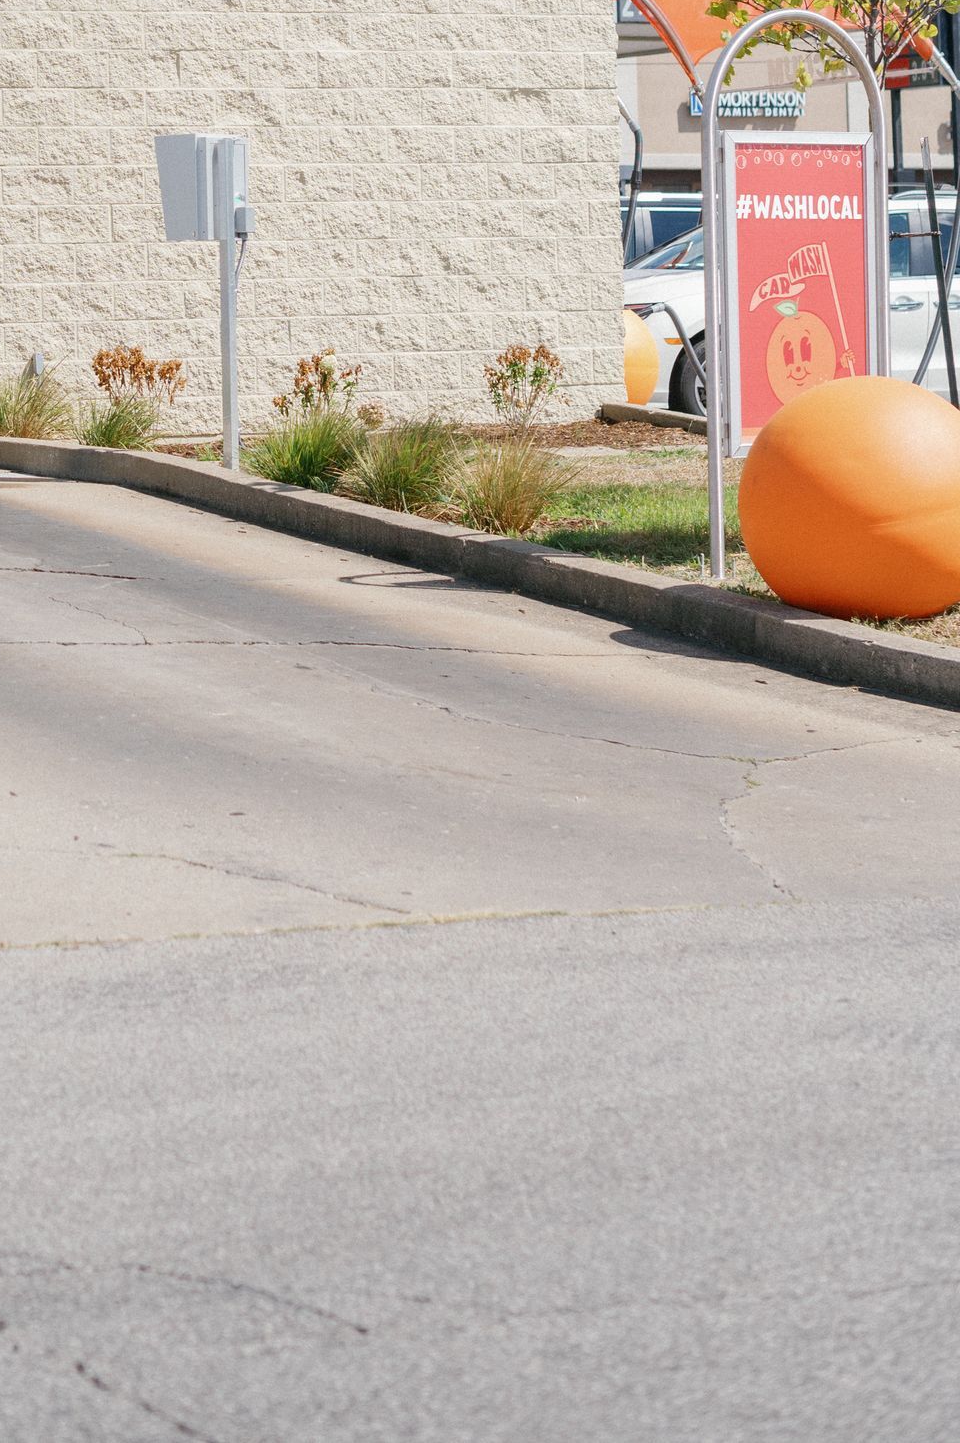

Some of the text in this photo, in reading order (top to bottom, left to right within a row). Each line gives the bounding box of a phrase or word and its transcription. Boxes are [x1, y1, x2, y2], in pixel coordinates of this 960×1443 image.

[718, 91, 806, 108] MORTENSON
[718, 107, 758, 117] FAMILY
[736, 194, 862, 220] #WASHLOCAL
[759, 246, 823, 299] CAR WASH
